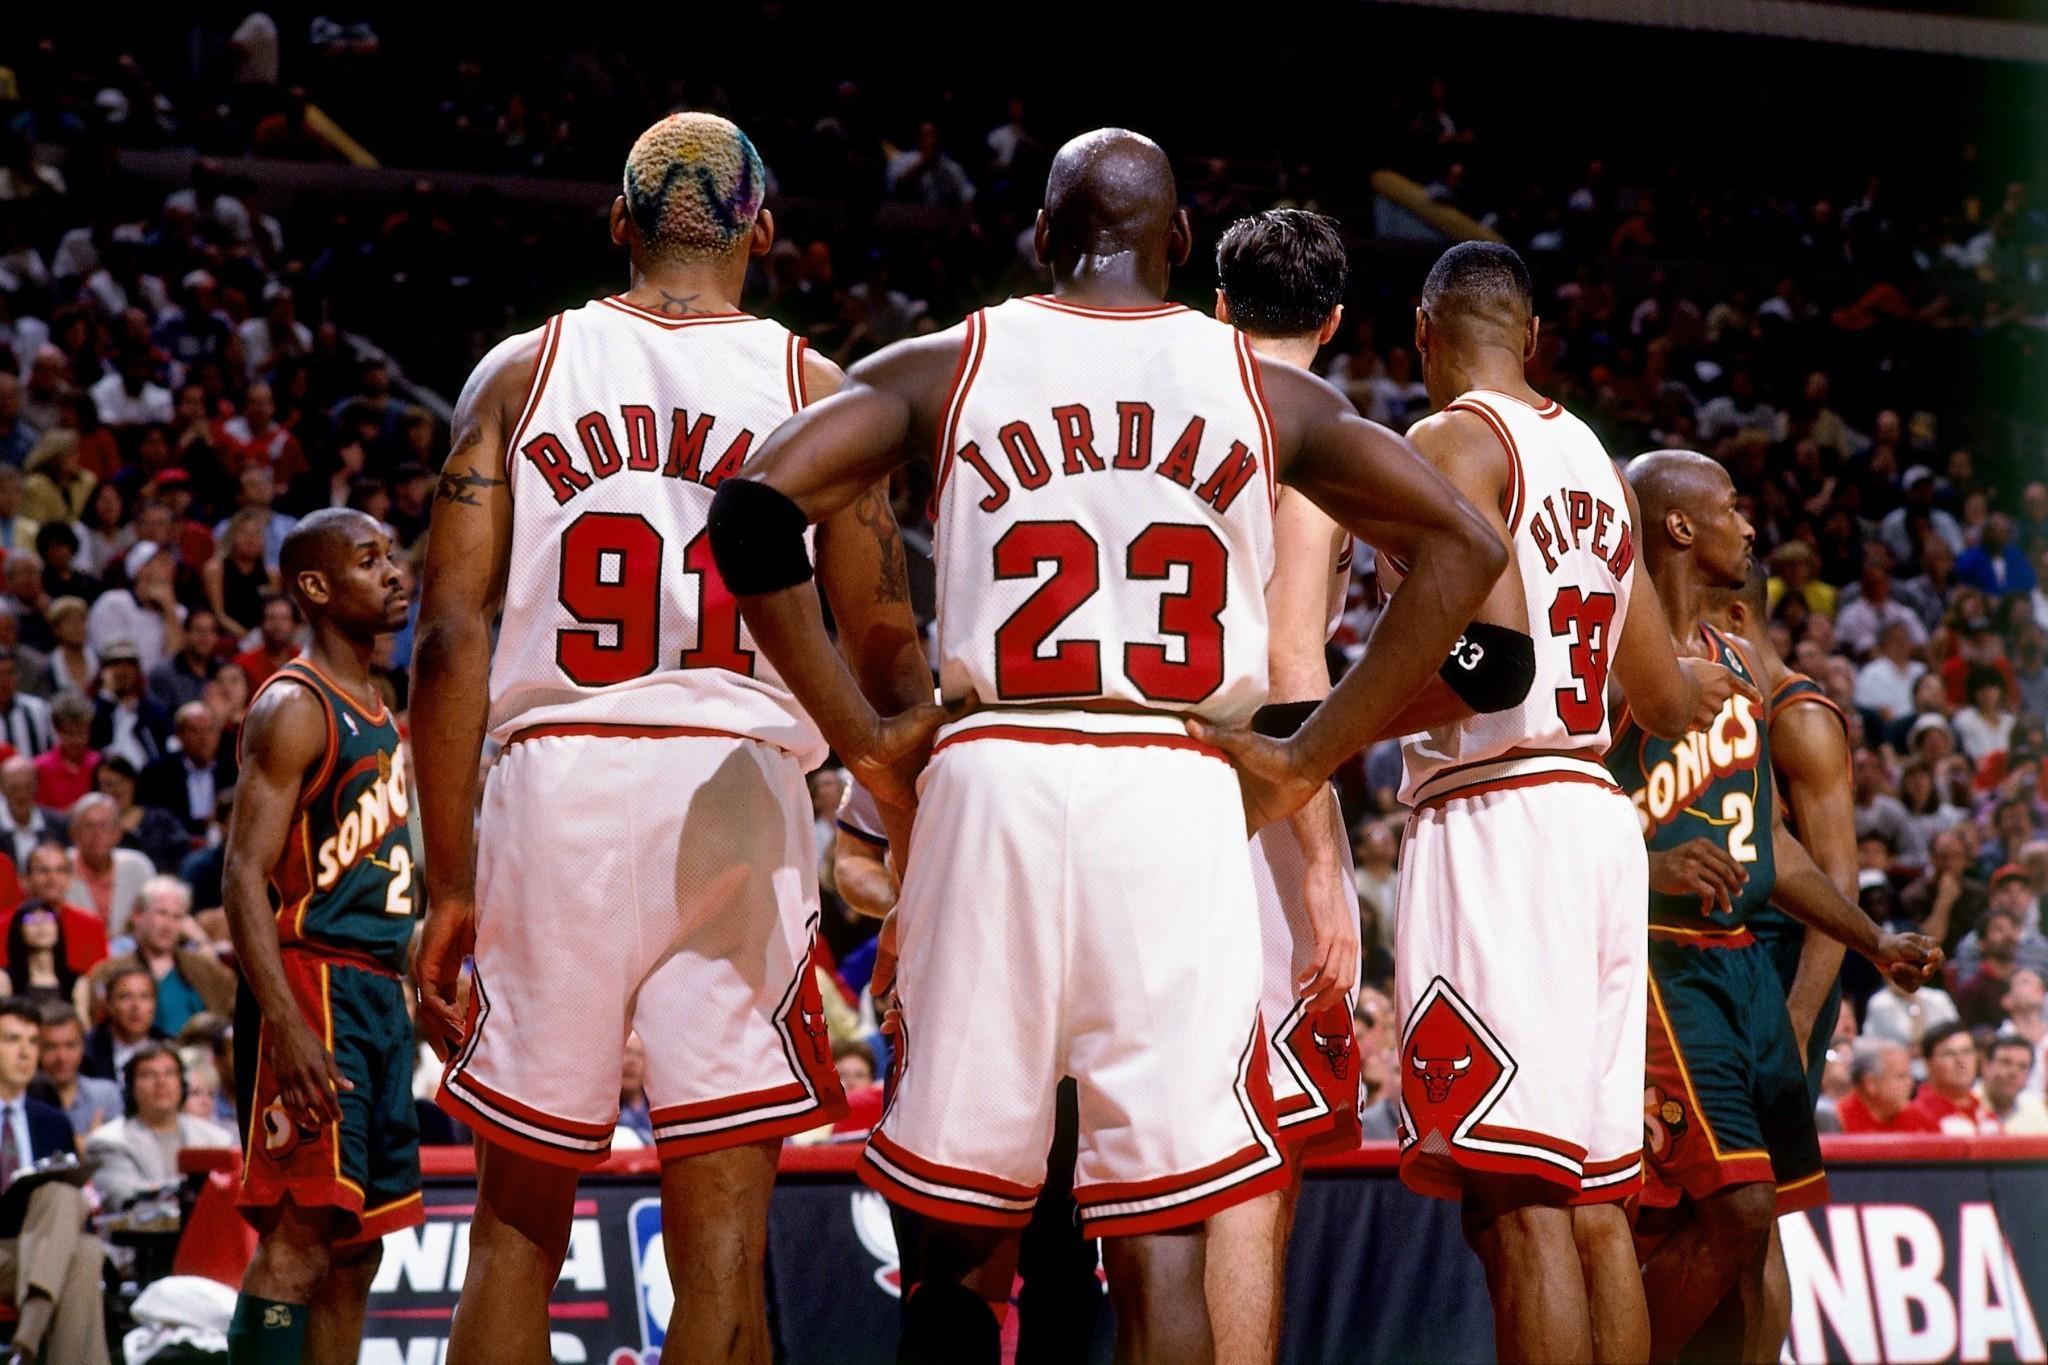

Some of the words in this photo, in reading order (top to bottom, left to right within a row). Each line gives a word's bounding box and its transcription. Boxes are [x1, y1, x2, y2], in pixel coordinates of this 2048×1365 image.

[521, 404, 754, 506] RODMA
[958, 401, 1258, 515] JORDAN
[1530, 488, 1634, 582] PIPEN
[555, 511, 755, 687] 91
[993, 520, 1229, 704] 23
[1450, 635, 1484, 670] 33
[1722, 792, 1757, 863] 2
[370, 1220, 606, 1293] NA
[1778, 1202, 2048, 1365] NBA
